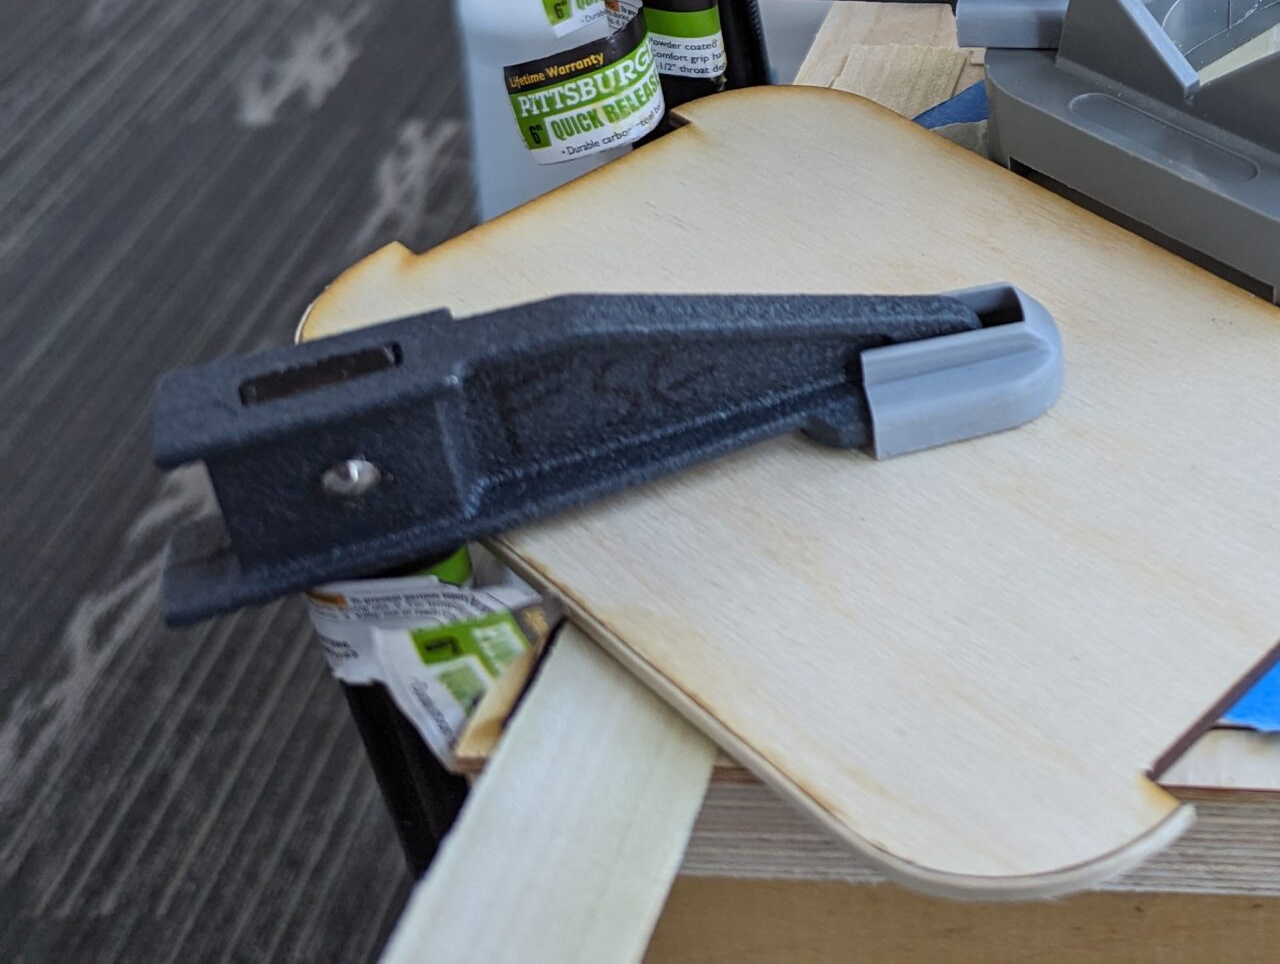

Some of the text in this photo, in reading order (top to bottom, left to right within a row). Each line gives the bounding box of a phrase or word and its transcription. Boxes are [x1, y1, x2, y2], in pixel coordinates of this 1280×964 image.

[684, 40, 718, 51] coated
[679, 65, 709, 74] throat
[690, 54, 710, 65] grip
[509, 52, 604, 89] Lifetime Warranty
[528, 123, 544, 145] 6"
[550, 109, 605, 141] QUICK
[566, 139, 600, 156] Durable
[601, 127, 632, 145] carbo
